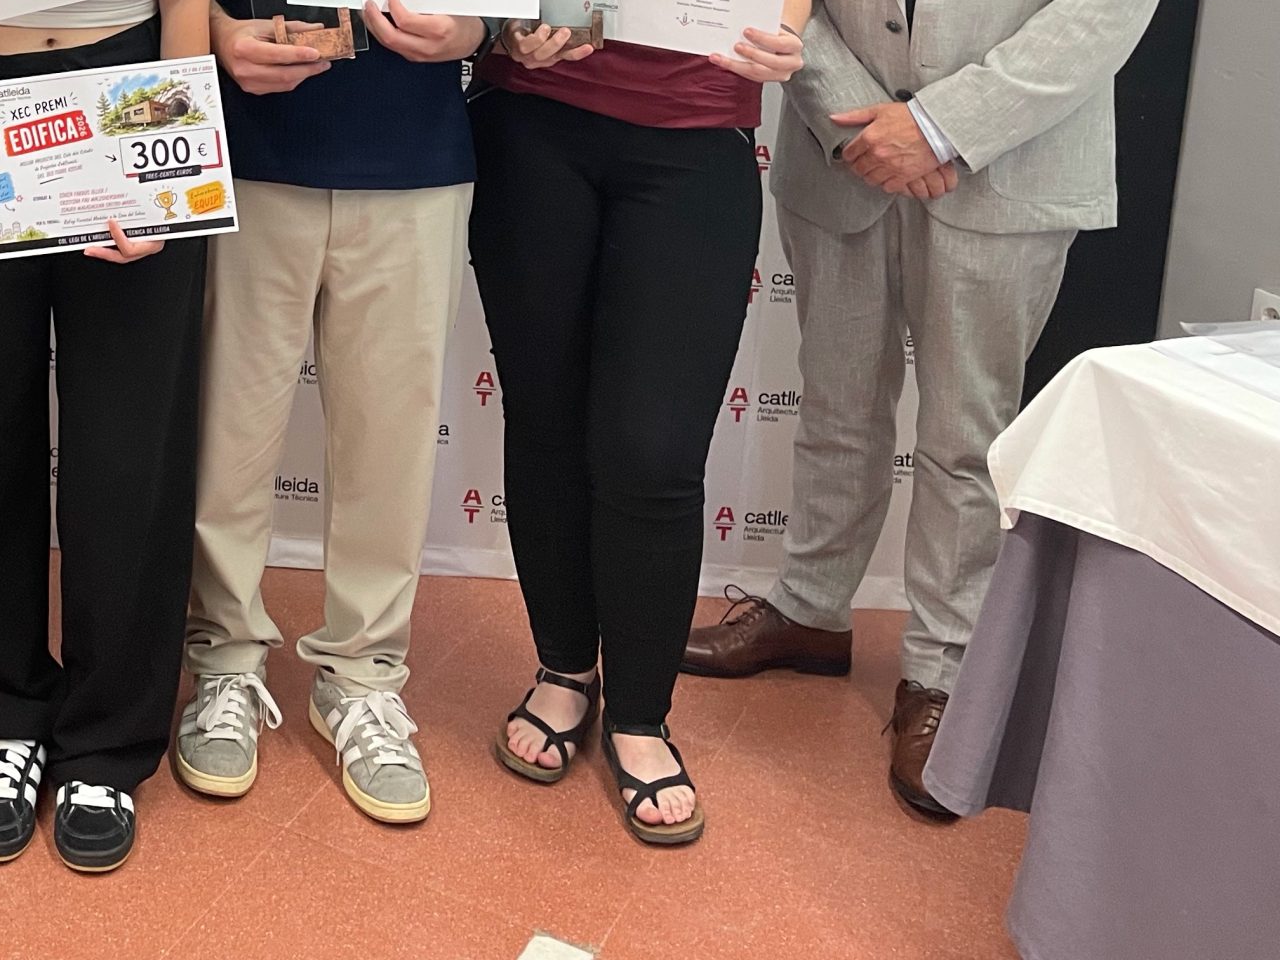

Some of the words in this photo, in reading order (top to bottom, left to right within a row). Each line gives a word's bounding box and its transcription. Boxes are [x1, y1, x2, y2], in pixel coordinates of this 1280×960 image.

[10, 106, 32, 121] XEC
[35, 96, 68, 115] PREMI
[8, 117, 77, 152] EDIFICA
[76, 116, 86, 138] 2026
[132, 136, 191, 169] 300
[757, 406, 799, 416] Arquitectur
